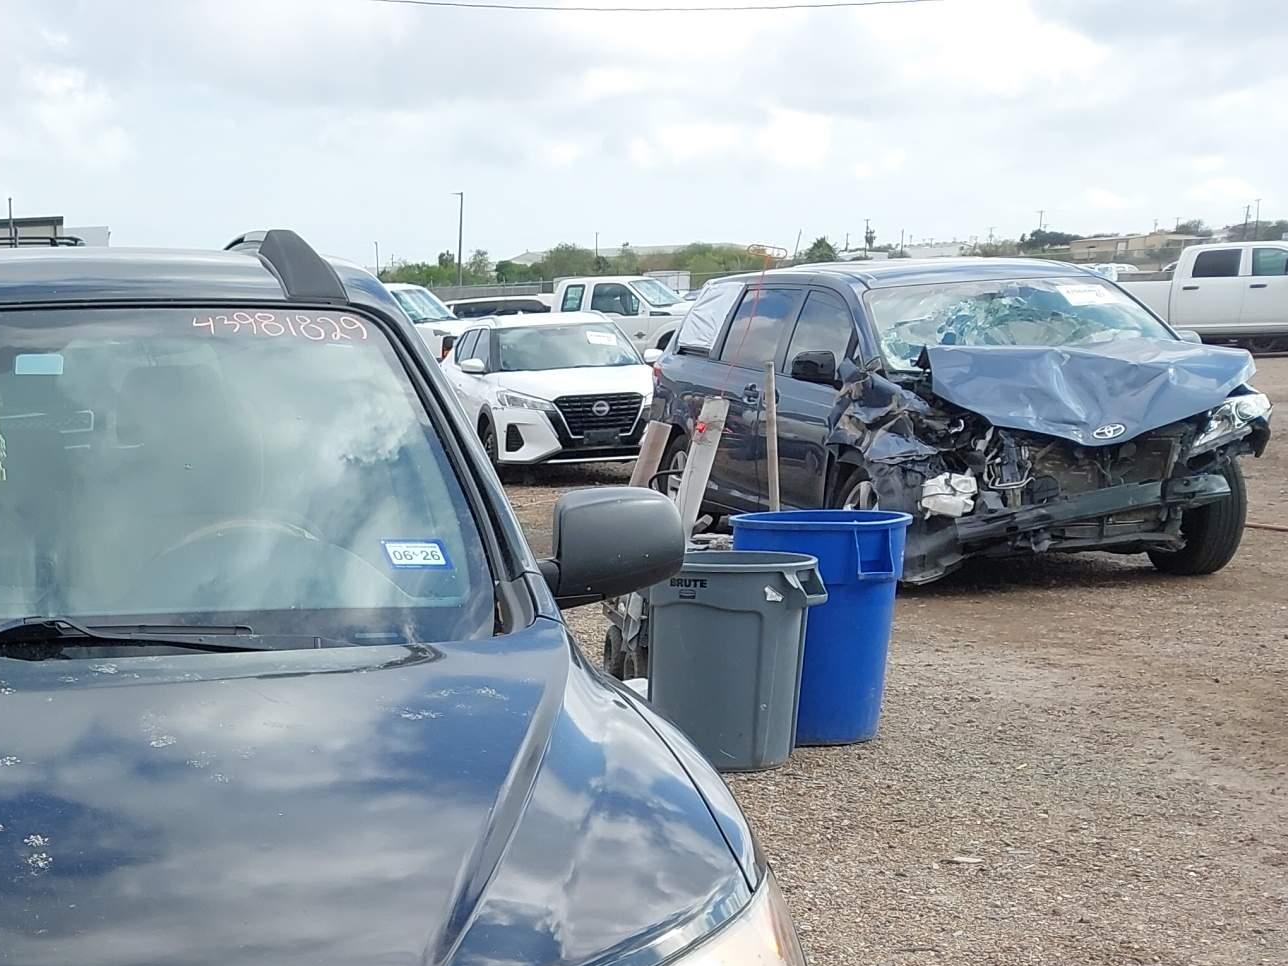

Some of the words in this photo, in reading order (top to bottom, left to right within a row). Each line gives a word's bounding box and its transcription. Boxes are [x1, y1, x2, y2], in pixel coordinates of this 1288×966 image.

[192, 311, 368, 340] 43981829
[393, 551, 414, 561] 06
[420, 550, 441, 561] 26
[670, 577, 708, 589] BRUTE
